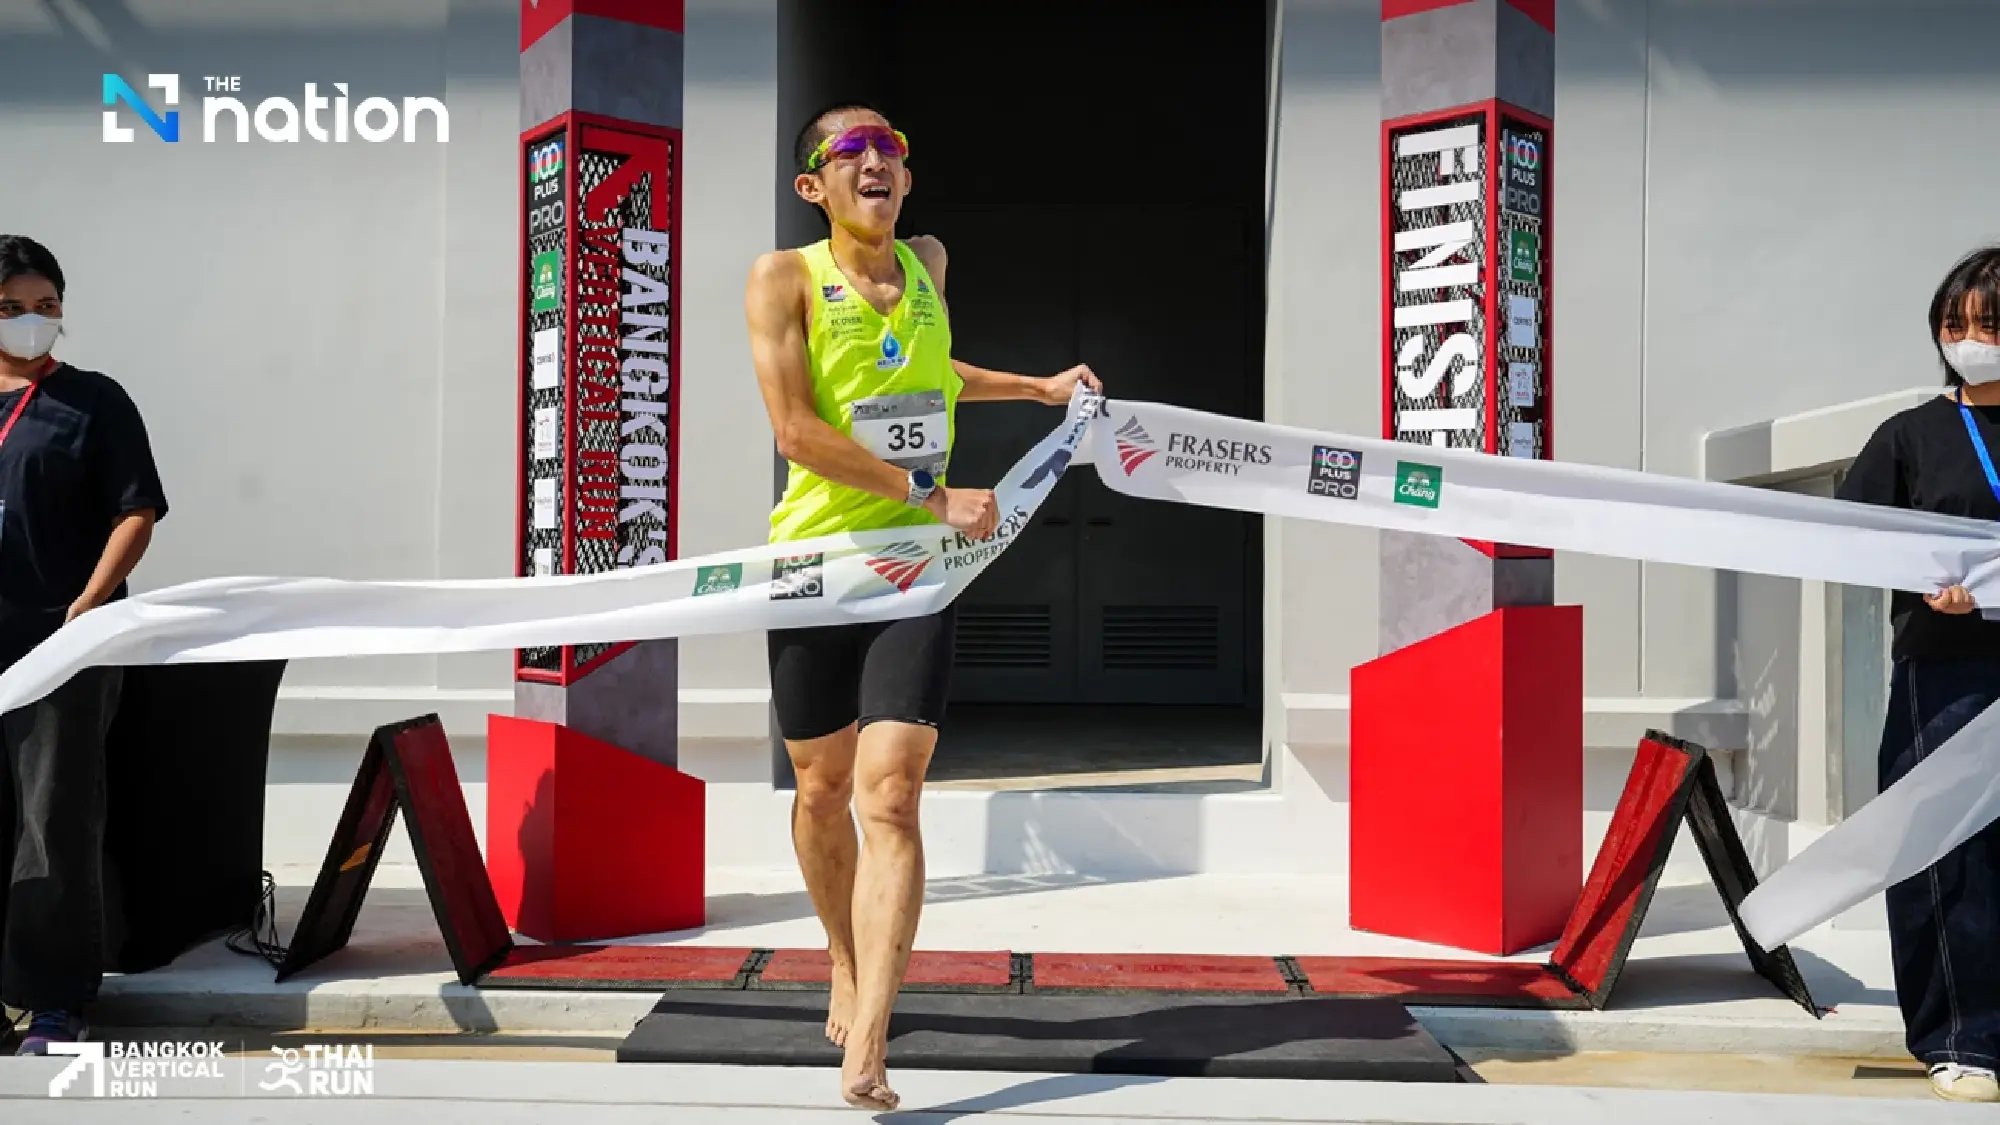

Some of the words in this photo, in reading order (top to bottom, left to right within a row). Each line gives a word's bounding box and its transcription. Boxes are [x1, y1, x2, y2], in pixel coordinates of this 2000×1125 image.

[532, 142, 559, 181] 100
[1510, 135, 1537, 169] 100
[534, 178, 559, 200] PLUS
[1511, 168, 1536, 187] PLUS
[1507, 187, 1540, 213] PRO
[530, 200, 565, 234] PRO
[581, 226, 620, 432] VERTICAL
[888, 422, 925, 452] 35
[1167, 432, 1273, 465] FRASERS
[1165, 455, 1243, 476] PROPERTY
[1315, 447, 1355, 469] 100
[1319, 466, 1351, 479] PLUS
[580, 451, 616, 540] RUN
[1308, 479, 1357, 499] PRO
[1398, 483, 1436, 500] Chang
